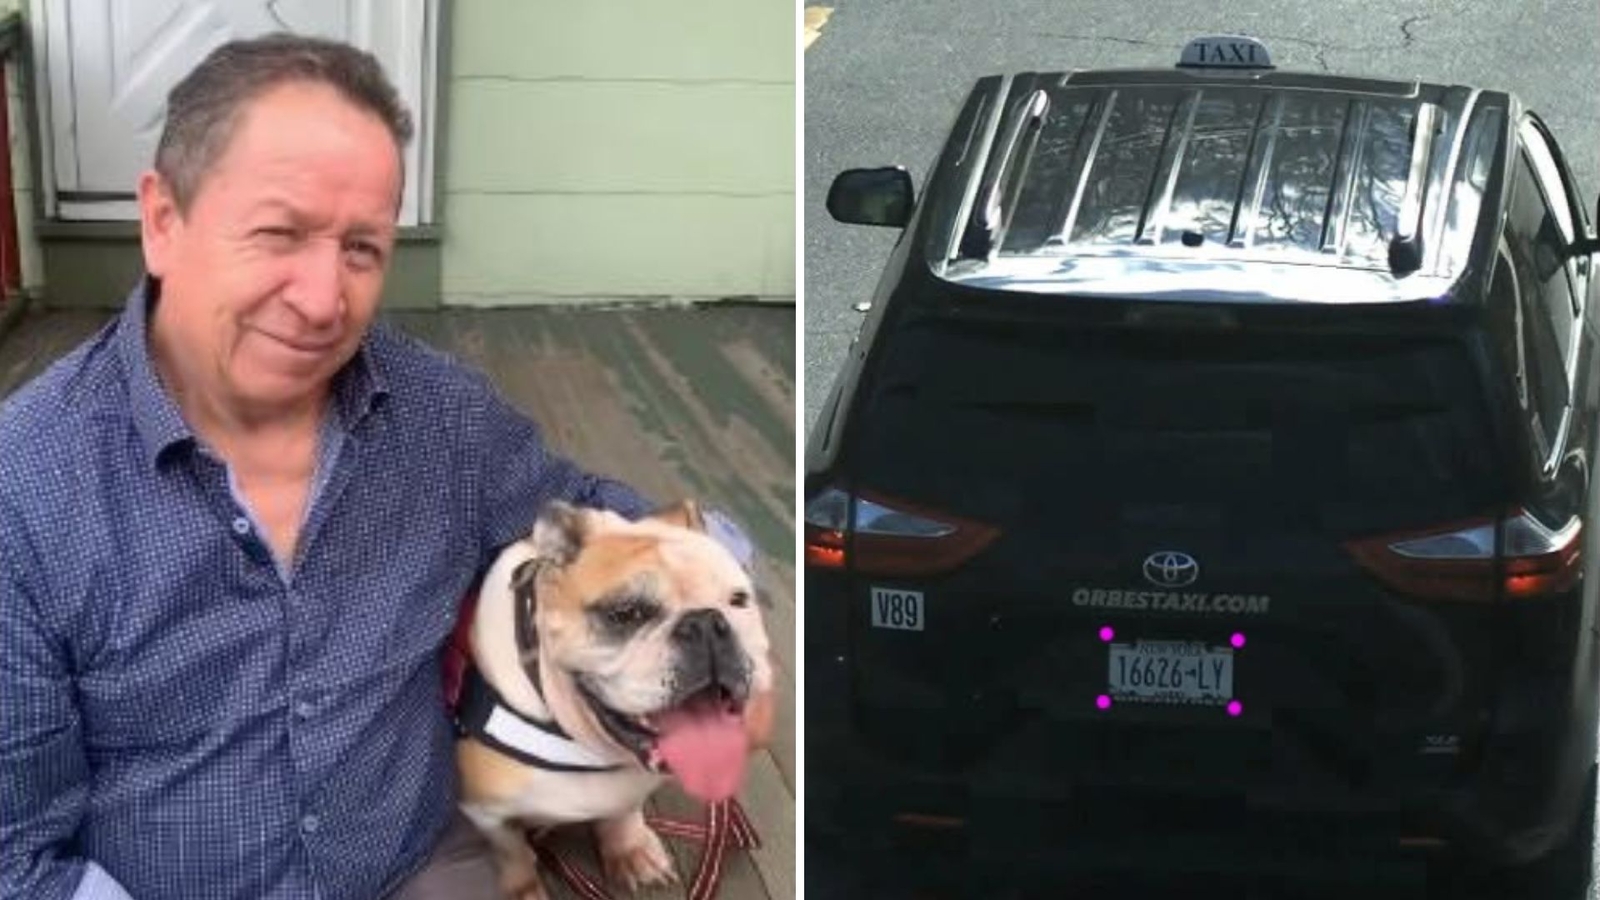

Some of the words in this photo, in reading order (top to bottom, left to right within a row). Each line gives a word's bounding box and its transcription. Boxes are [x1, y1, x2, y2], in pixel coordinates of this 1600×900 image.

[1193, 43, 1257, 62] TAXI
[877, 592, 917, 627] V89
[1072, 588, 1270, 613] ORBESTAXI.COM
